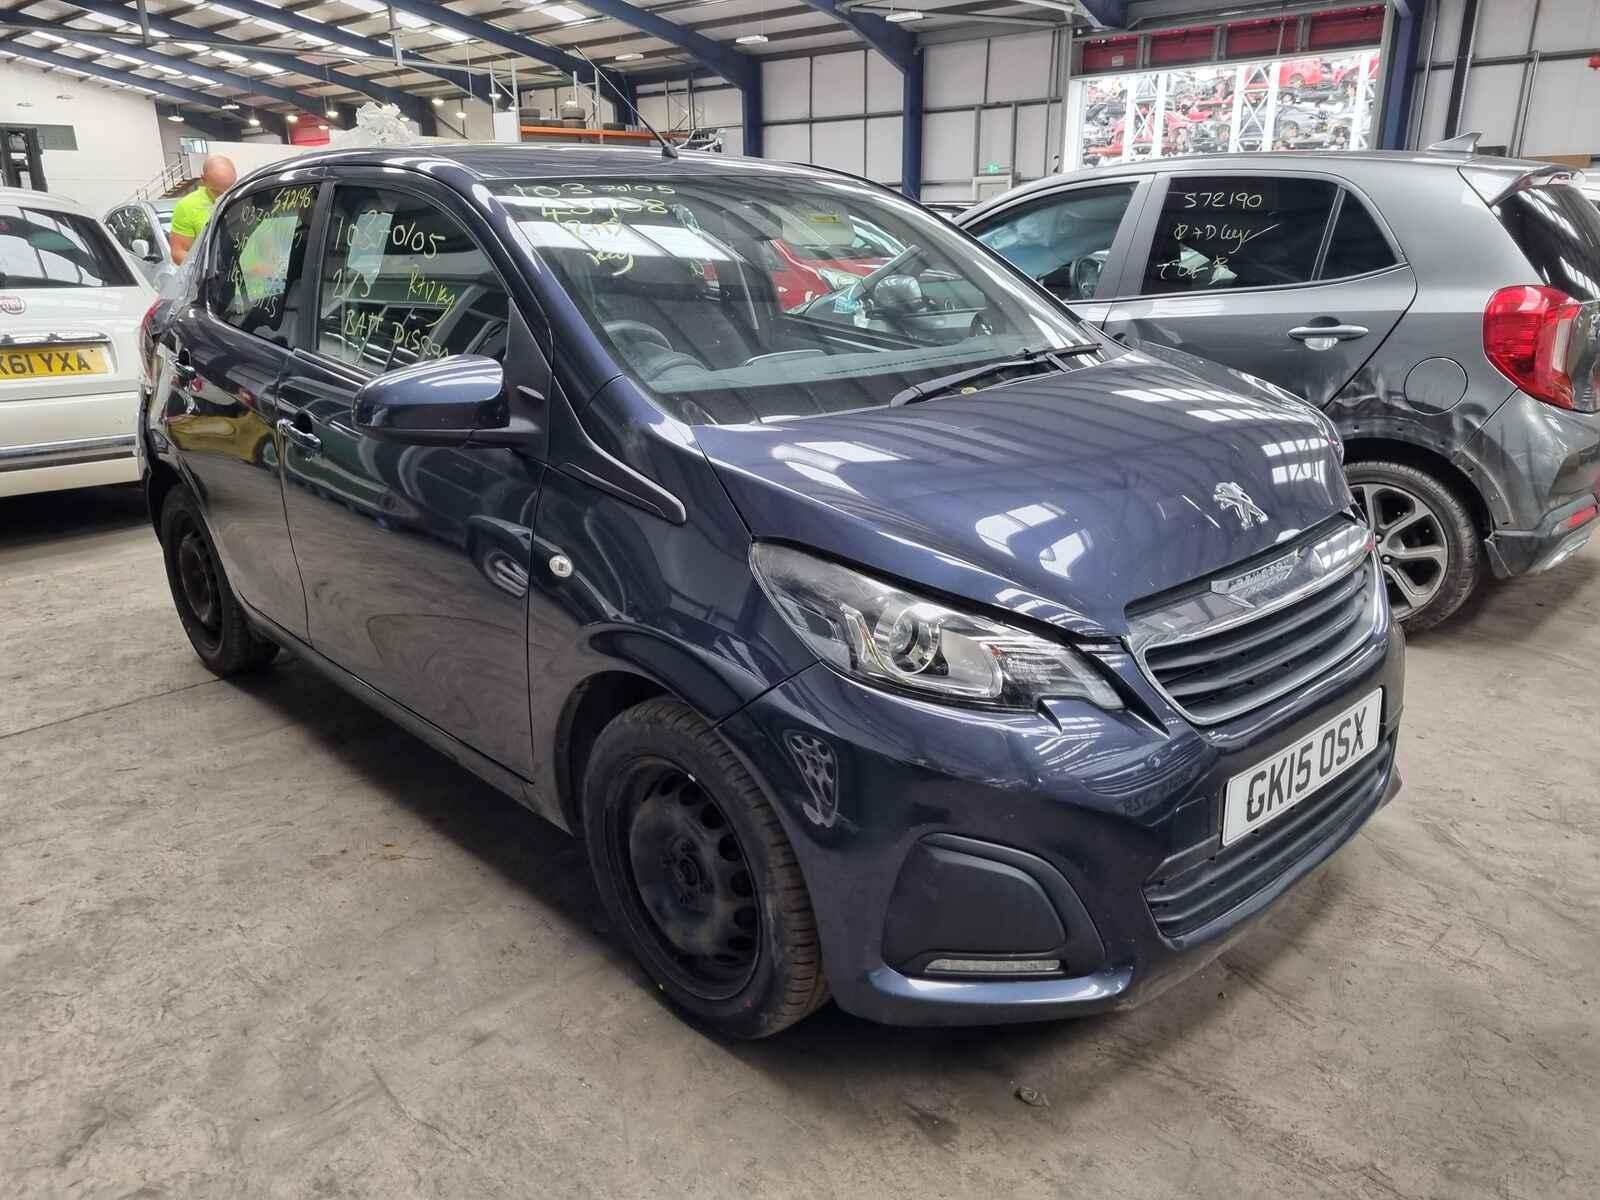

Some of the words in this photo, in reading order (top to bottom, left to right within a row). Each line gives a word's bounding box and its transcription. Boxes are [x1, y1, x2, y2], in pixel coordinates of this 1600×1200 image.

[37, 352, 91, 373] YXA
[1246, 741, 1314, 822] GK15
[1318, 706, 1367, 778] OSX
